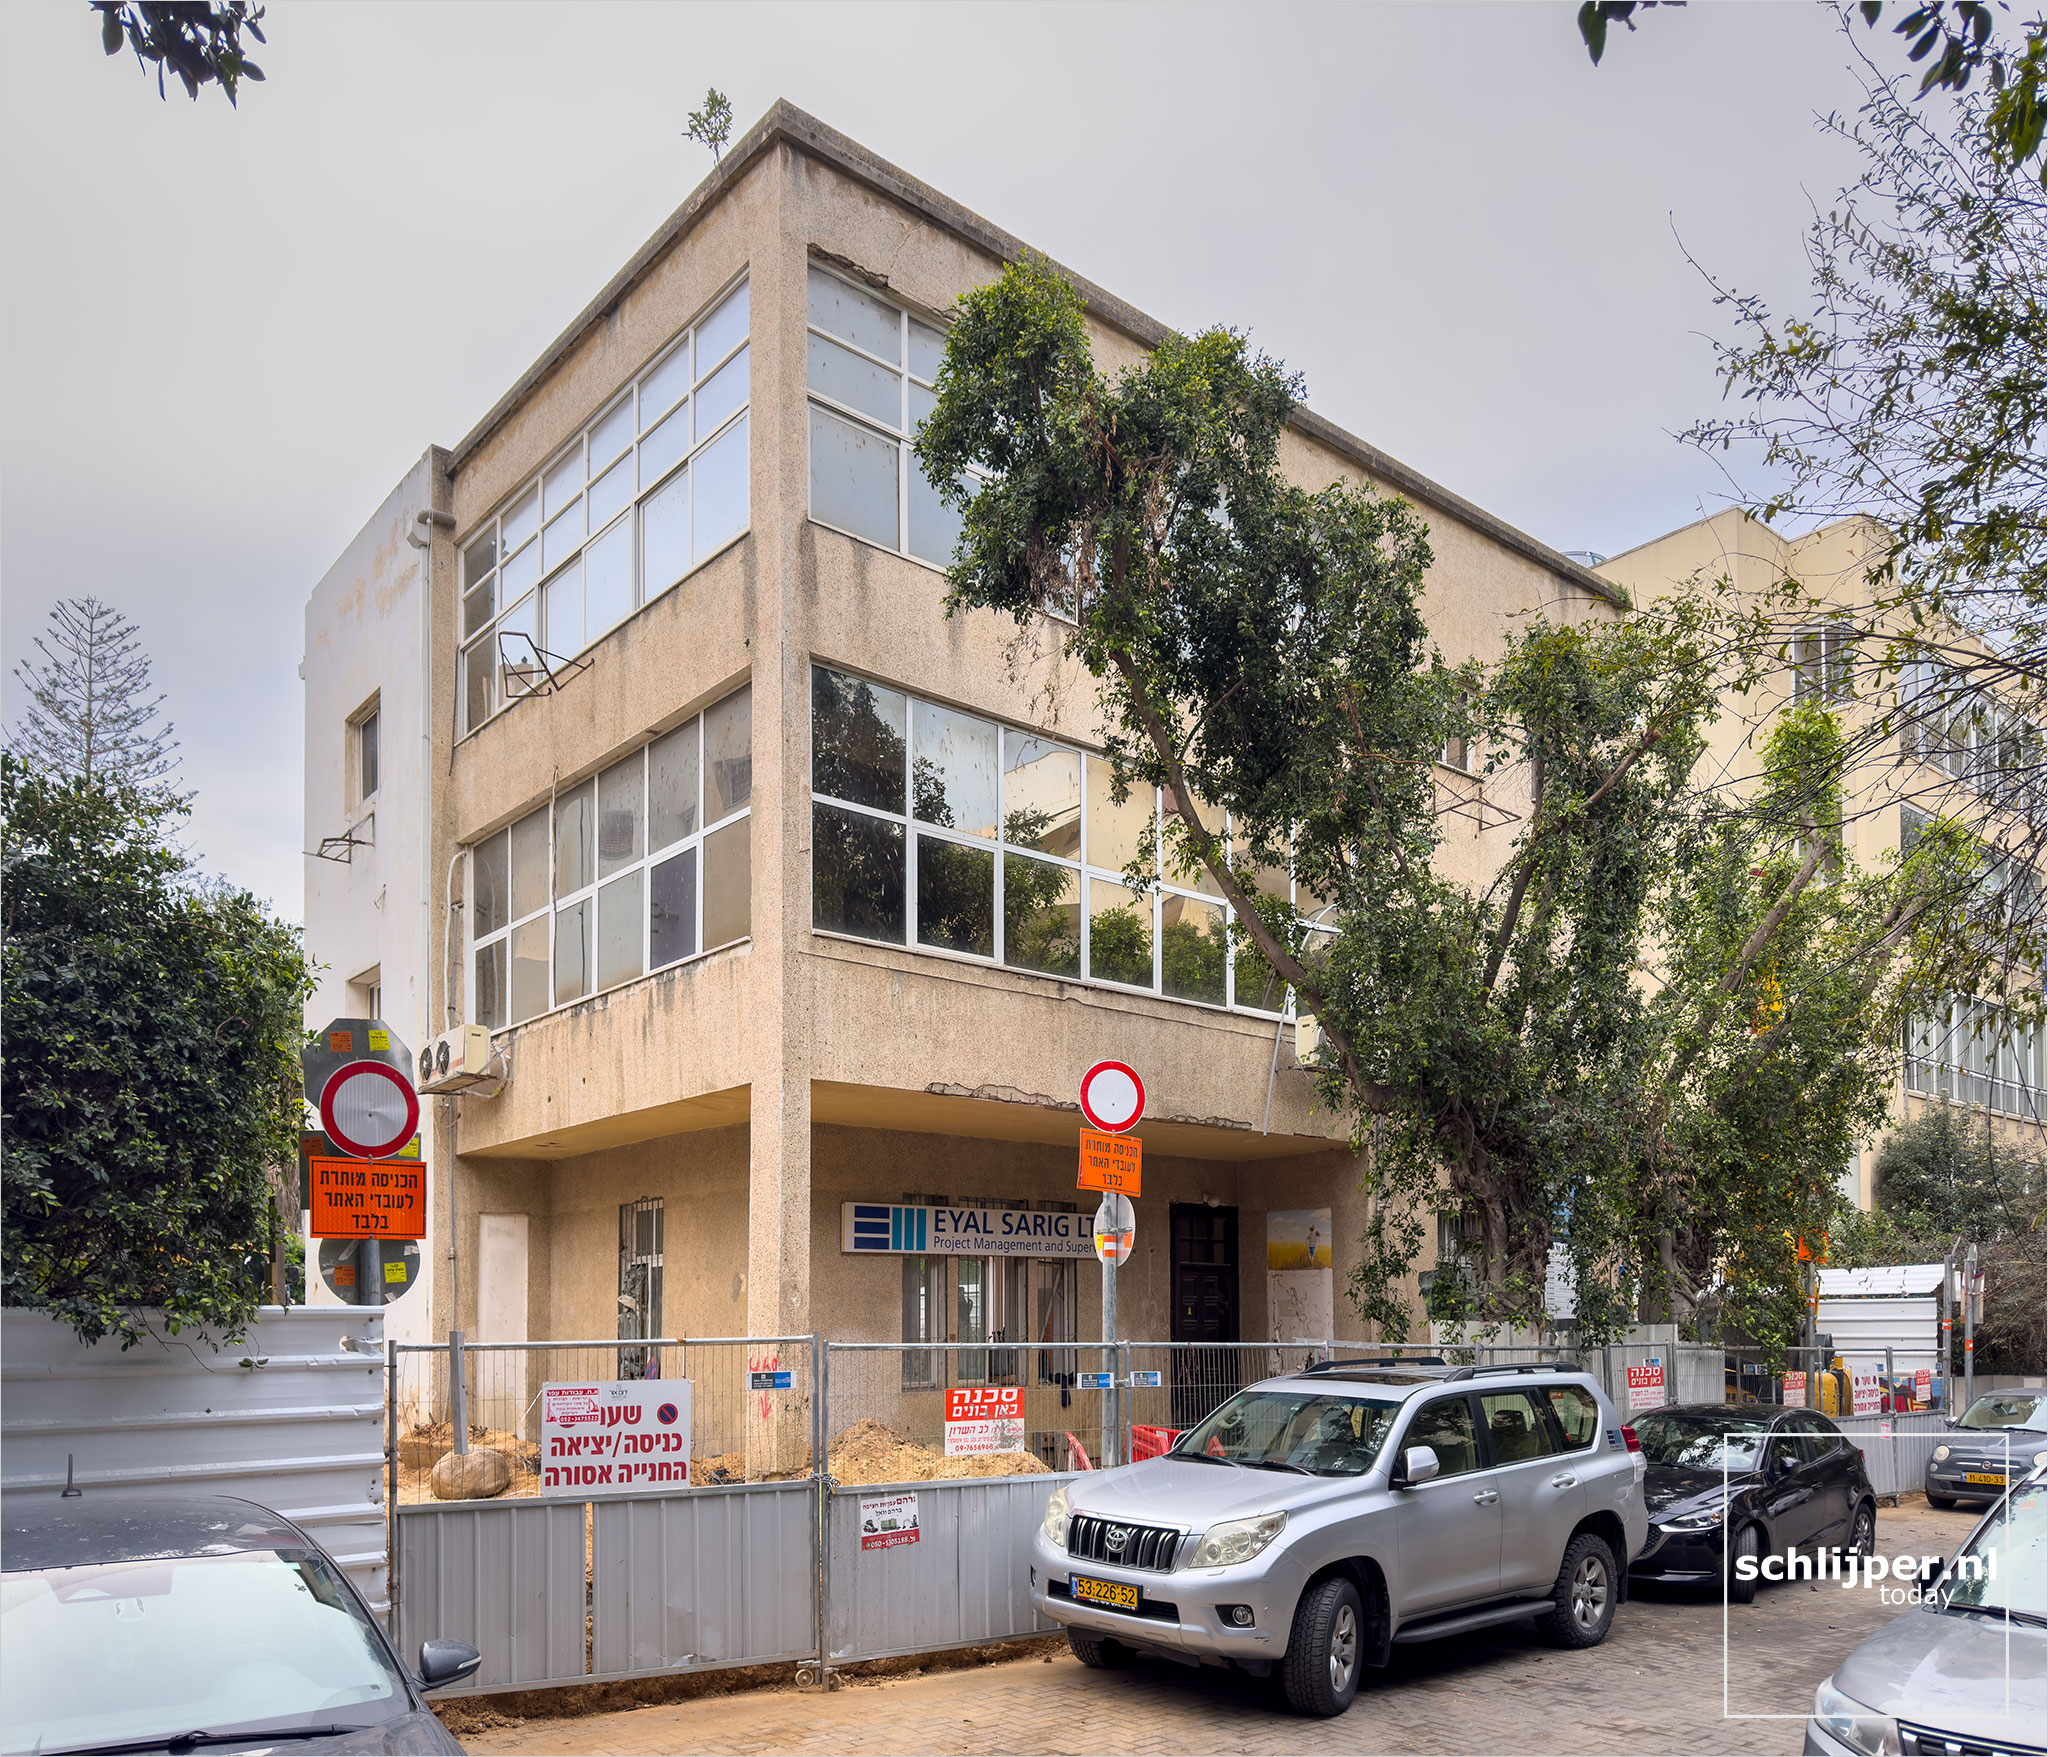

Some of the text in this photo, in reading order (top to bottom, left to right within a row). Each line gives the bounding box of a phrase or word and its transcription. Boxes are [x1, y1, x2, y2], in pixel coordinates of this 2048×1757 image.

[320, 1170, 418, 1188] הכניסה מותרת
[324, 1192, 414, 1209] לעובדי האתר
[352, 1213, 389, 1229] בלבד
[934, 1209, 1094, 1238] EYAL SARIG LT
[933, 1235, 971, 1251] Project
[974, 1237, 1042, 1253] Management
[1044, 1240, 1063, 1252] and
[1631, 1367, 1661, 1377] סכנה
[953, 1388, 1018, 1404] סכנה
[952, 1404, 1018, 1418] כאן בונים
[949, 1425, 976, 1437] השרון
[978, 1424, 989, 1434] לב
[551, 1431, 683, 1458] כניסה/יציאה
[545, 1461, 687, 1486] החנייה אסורה
